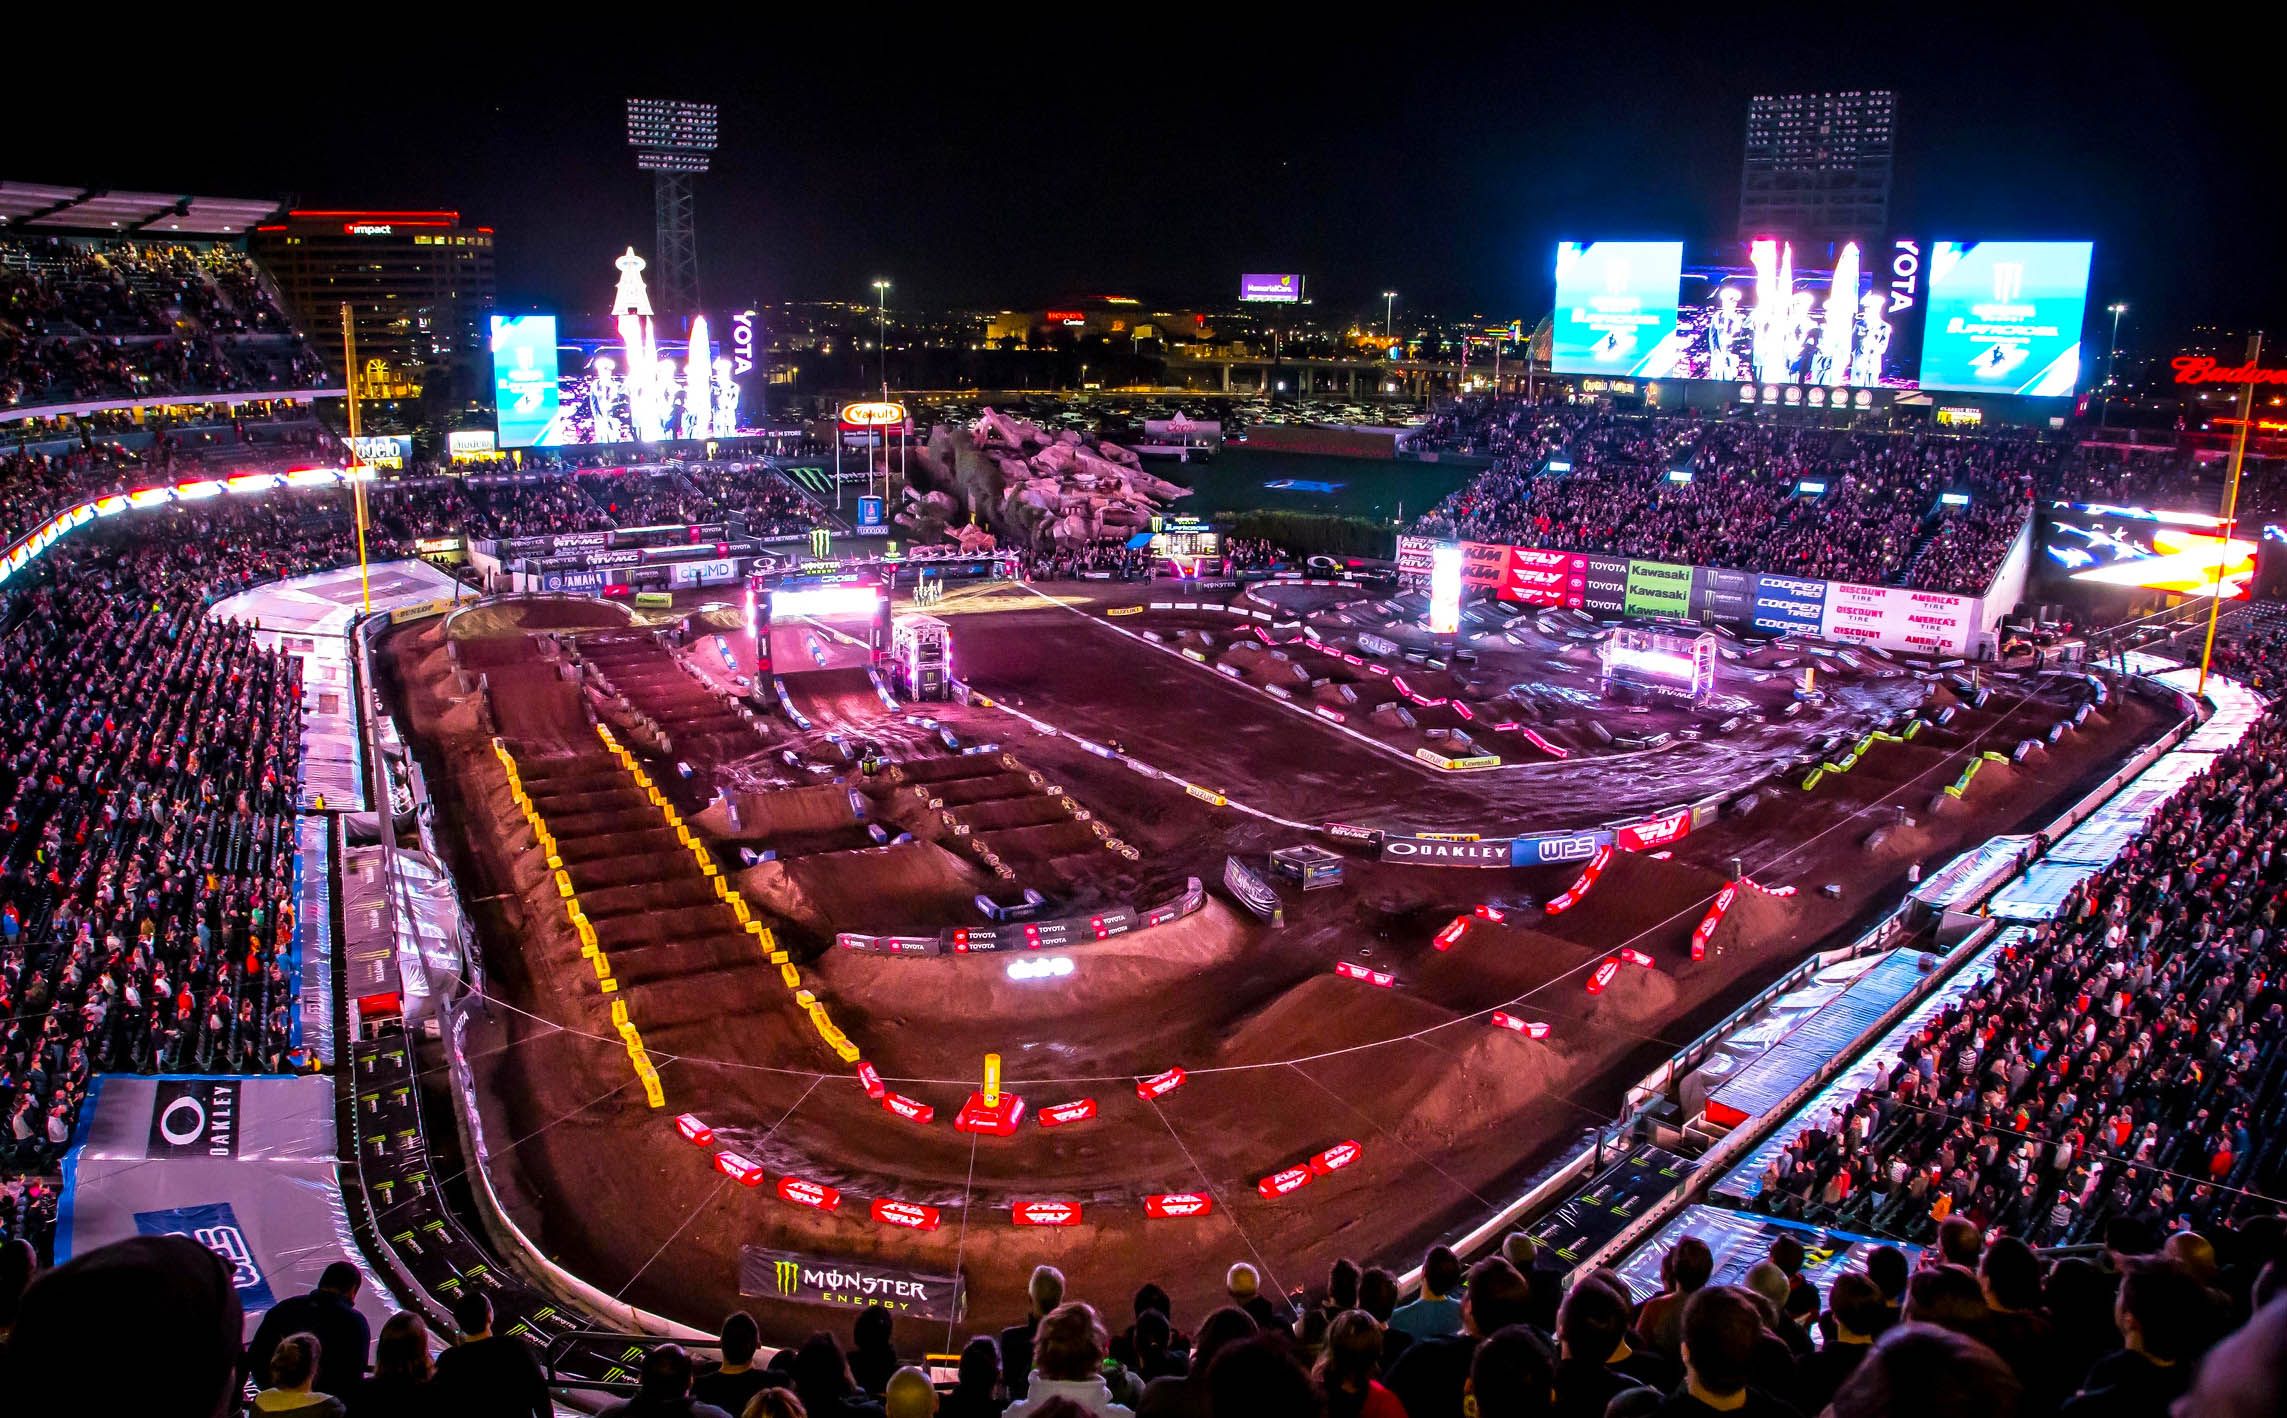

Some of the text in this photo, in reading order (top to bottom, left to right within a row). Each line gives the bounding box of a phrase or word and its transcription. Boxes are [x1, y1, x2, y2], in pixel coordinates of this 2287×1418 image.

[349, 225, 391, 235] impact
[1583, 379, 1635, 394] Captain Morgan
[511, 539, 545, 547] MONSTER
[1463, 548, 1502, 561] KTM
[1515, 550, 1566, 564] FLY
[1461, 566, 1500, 579] KTM
[1589, 561, 1627, 573] TOYOTA
[1632, 565, 1690, 580] Kawasaki
[1512, 569, 1564, 583] FLY
[1587, 580, 1624, 592] TOYOTA
[1760, 578, 1825, 593] COOPER
[1840, 585, 1886, 597] DISCOUNT
[1629, 585, 1687, 600] Kawasaki
[1790, 590, 1823, 598] TIRES
[1852, 594, 1872, 602] TIRE
[1585, 599, 1623, 611] TOYOTA
[1757, 598, 1822, 613] COOPER
[1911, 594, 1960, 606] AMERICA'S
[400, 604, 434, 618] DUNLOP
[1788, 609, 1819, 618] TIRES
[1836, 606, 1883, 618] DISCOUNT
[1755, 618, 1820, 633] COOPER
[1849, 615, 1869, 623] TIRE
[1908, 615, 1957, 627] AMERICA'S
[1833, 626, 1880, 639] DISCOUNT
[1420, 751, 1445, 766] SUZUKI
[1190, 788, 1217, 803] SUZUKI
[1633, 816, 1681, 841] FLY
[1420, 845, 1507, 859] OAKLEY
[1539, 836, 1595, 861] WPS
[1103, 914, 1126, 925] TOYOTA
[1159, 912, 1175, 922] TOYOTA
[1039, 925, 1066, 933] TOYOTA
[1108, 925, 1128, 935] TOYOTA
[1041, 937, 1067, 945] TOYOTA
[1052, 1104, 1089, 1122] FLY
[209, 1086, 233, 1156] OAKLEY
[1160, 1204, 1203, 1216] FLY
[879, 1210, 925, 1226] FLY
[1024, 1212, 1074, 1223] FLY
[803, 1268, 928, 1301] MONSTER
[823, 1292, 909, 1311] ENERGY
[552, 1314, 577, 1331] MONSTER
